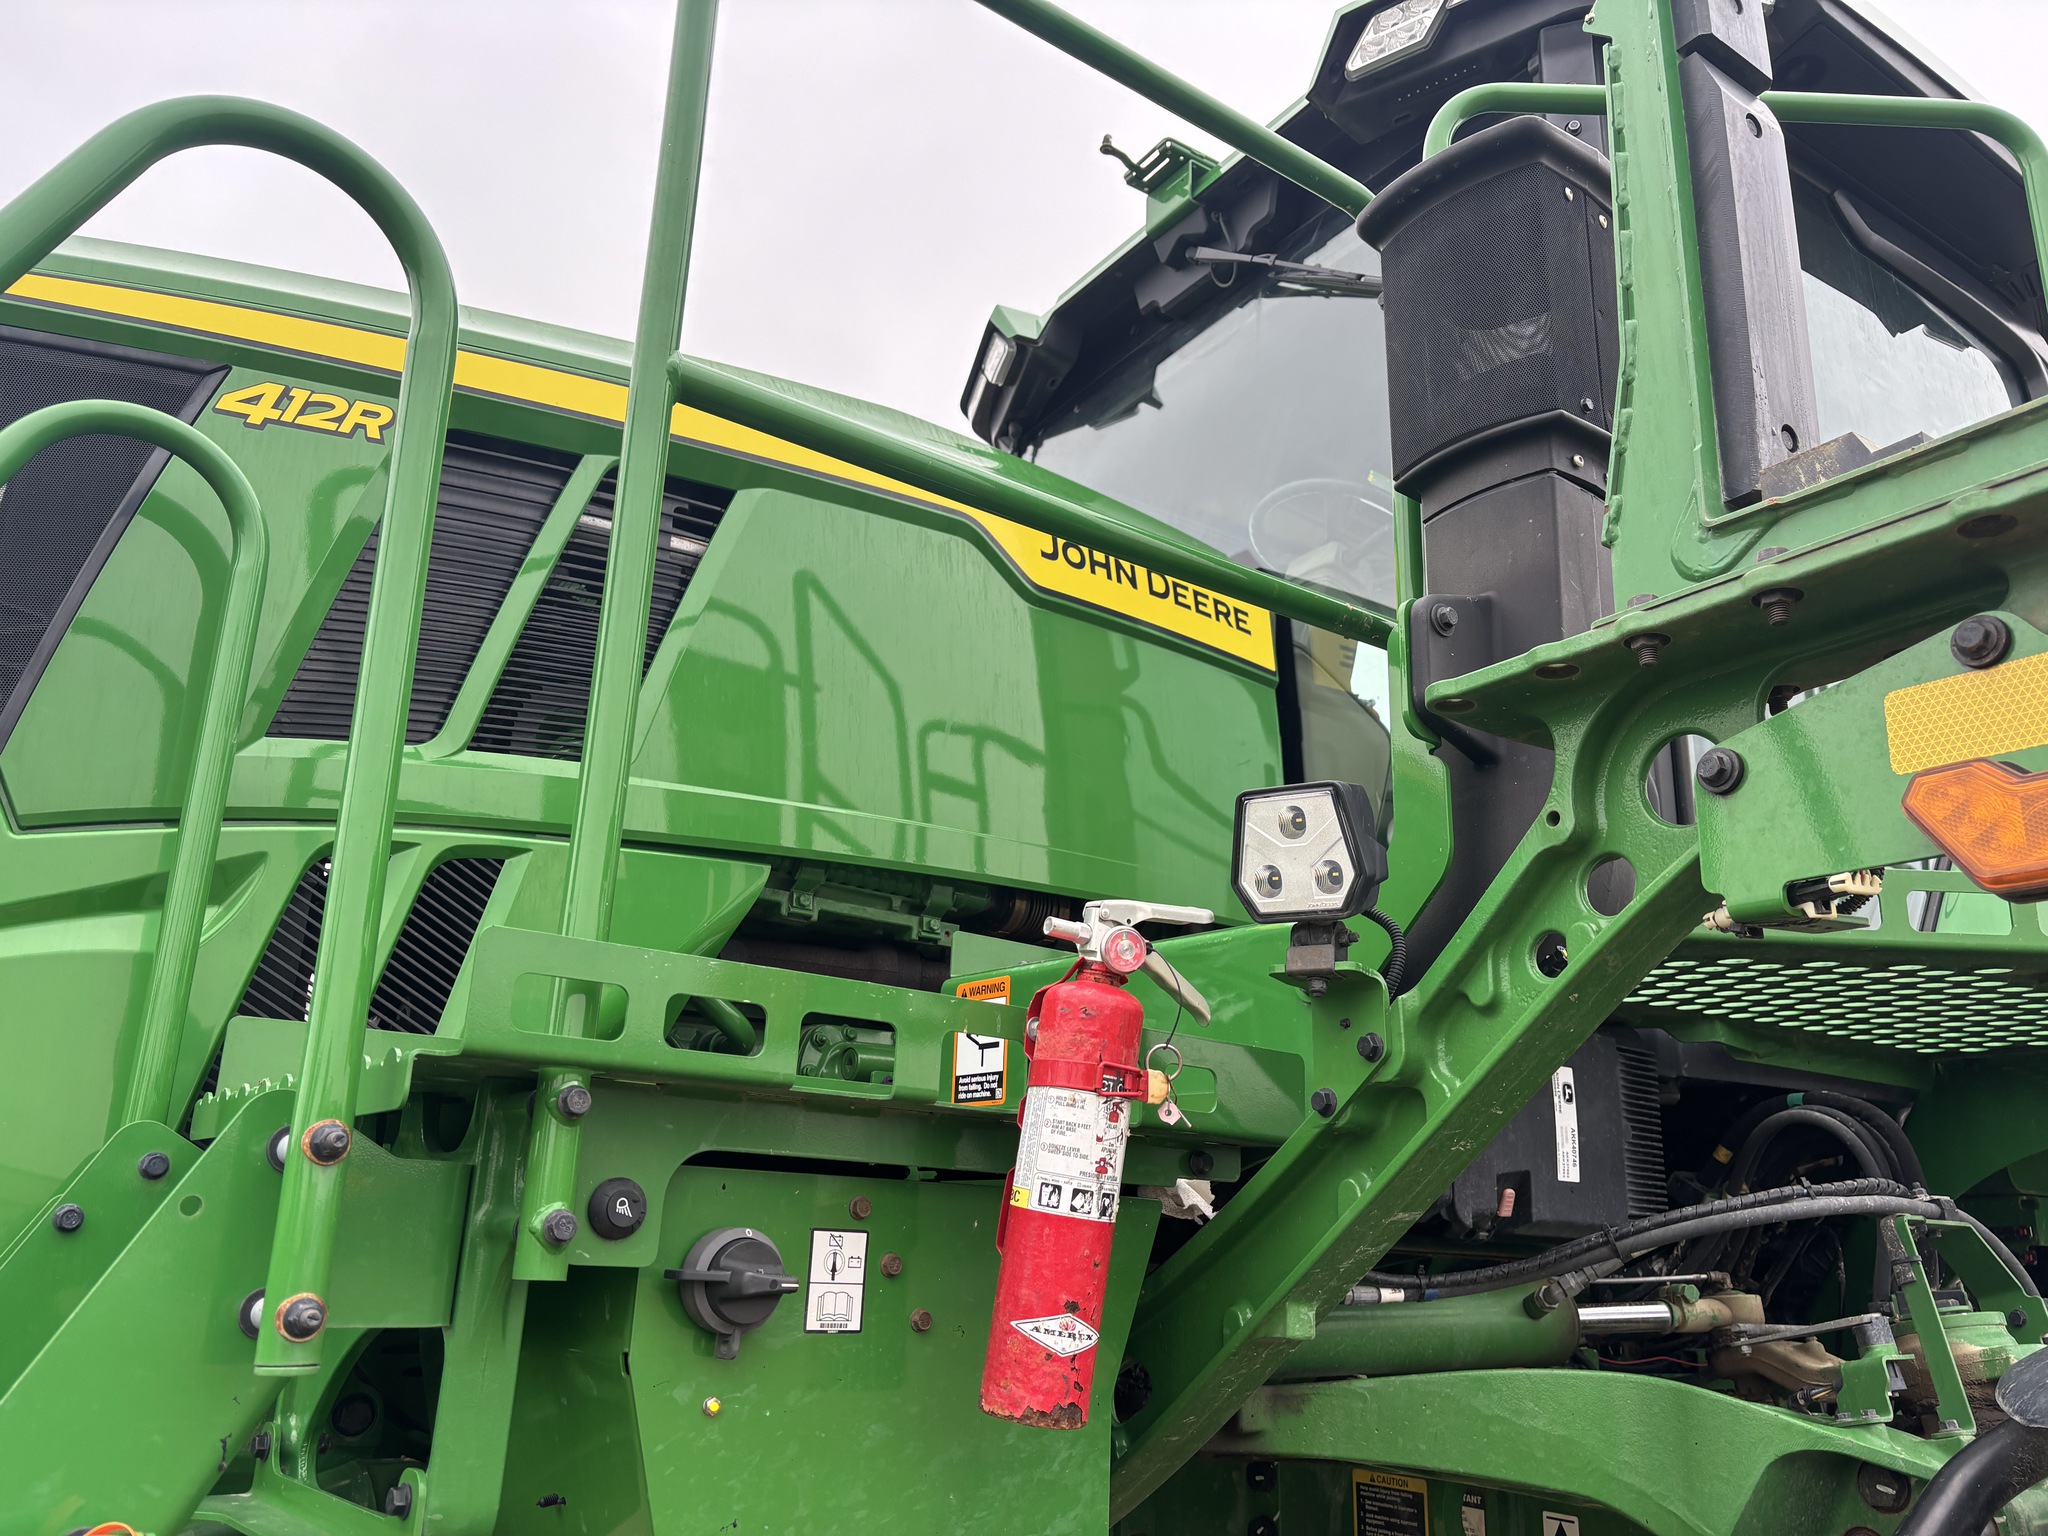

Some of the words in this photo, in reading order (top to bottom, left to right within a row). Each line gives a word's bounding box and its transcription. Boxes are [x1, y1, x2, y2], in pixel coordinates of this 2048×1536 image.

[213, 381, 396, 445] 412R
[1040, 536, 1138, 590] JOHN
[1146, 568, 1252, 636] DEERE
[969, 982, 1006, 997] WARNING
[986, 1074, 999, 1082] injury
[973, 1090, 991, 1098] machine.
[1030, 1326, 1093, 1342] AMEREX
[1376, 1475, 1408, 1488] CAUTION
